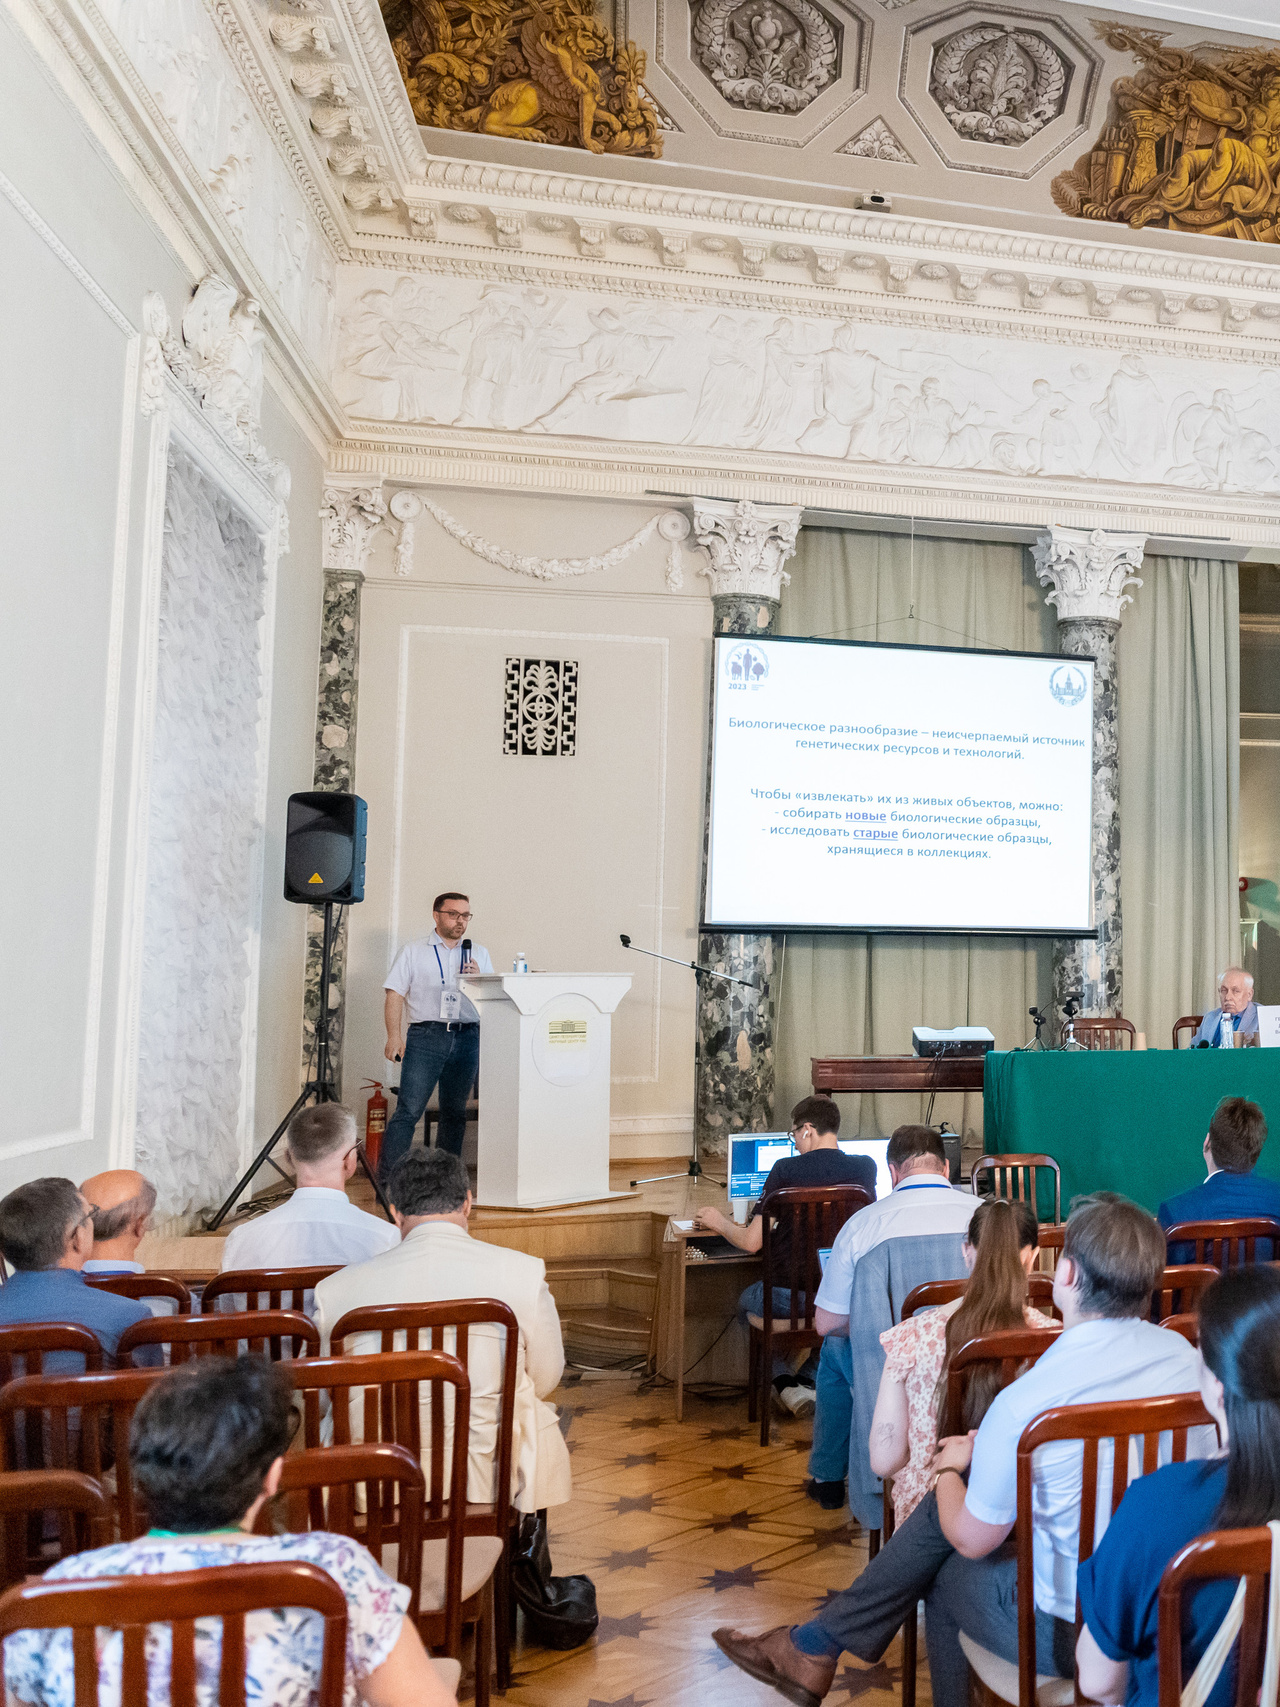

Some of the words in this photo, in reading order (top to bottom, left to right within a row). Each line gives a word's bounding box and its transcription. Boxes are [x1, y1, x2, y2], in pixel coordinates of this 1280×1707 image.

[729, 718, 825, 731] Биологическое
[830, 725, 918, 736] разнообразие
[933, 731, 1028, 743] неисчерпаемый
[1033, 737, 1085, 746] источник
[796, 740, 879, 751] генетических
[884, 745, 939, 755] ресурсов
[954, 749, 1024, 759] технологий.
[751, 789, 790, 799] Чтобы
[795, 793, 873, 802] «извлекать»
[913, 798, 952, 806] живых
[957, 797, 1015, 810] объектов,
[1019, 802, 1062, 811] можно:
[783, 807, 842, 820] собирать
[846, 812, 887, 823] новые
[891, 811, 982, 824] биологические
[986, 815, 1040, 828] образцы,
[770, 827, 849, 837] исследовать
[853, 830, 898, 841] старые
[902, 829, 993, 841] биологические
[997, 832, 1051, 845] образцы,
[828, 846, 903, 856] хранящиеся
[918, 849, 991, 860] коллекциях.
